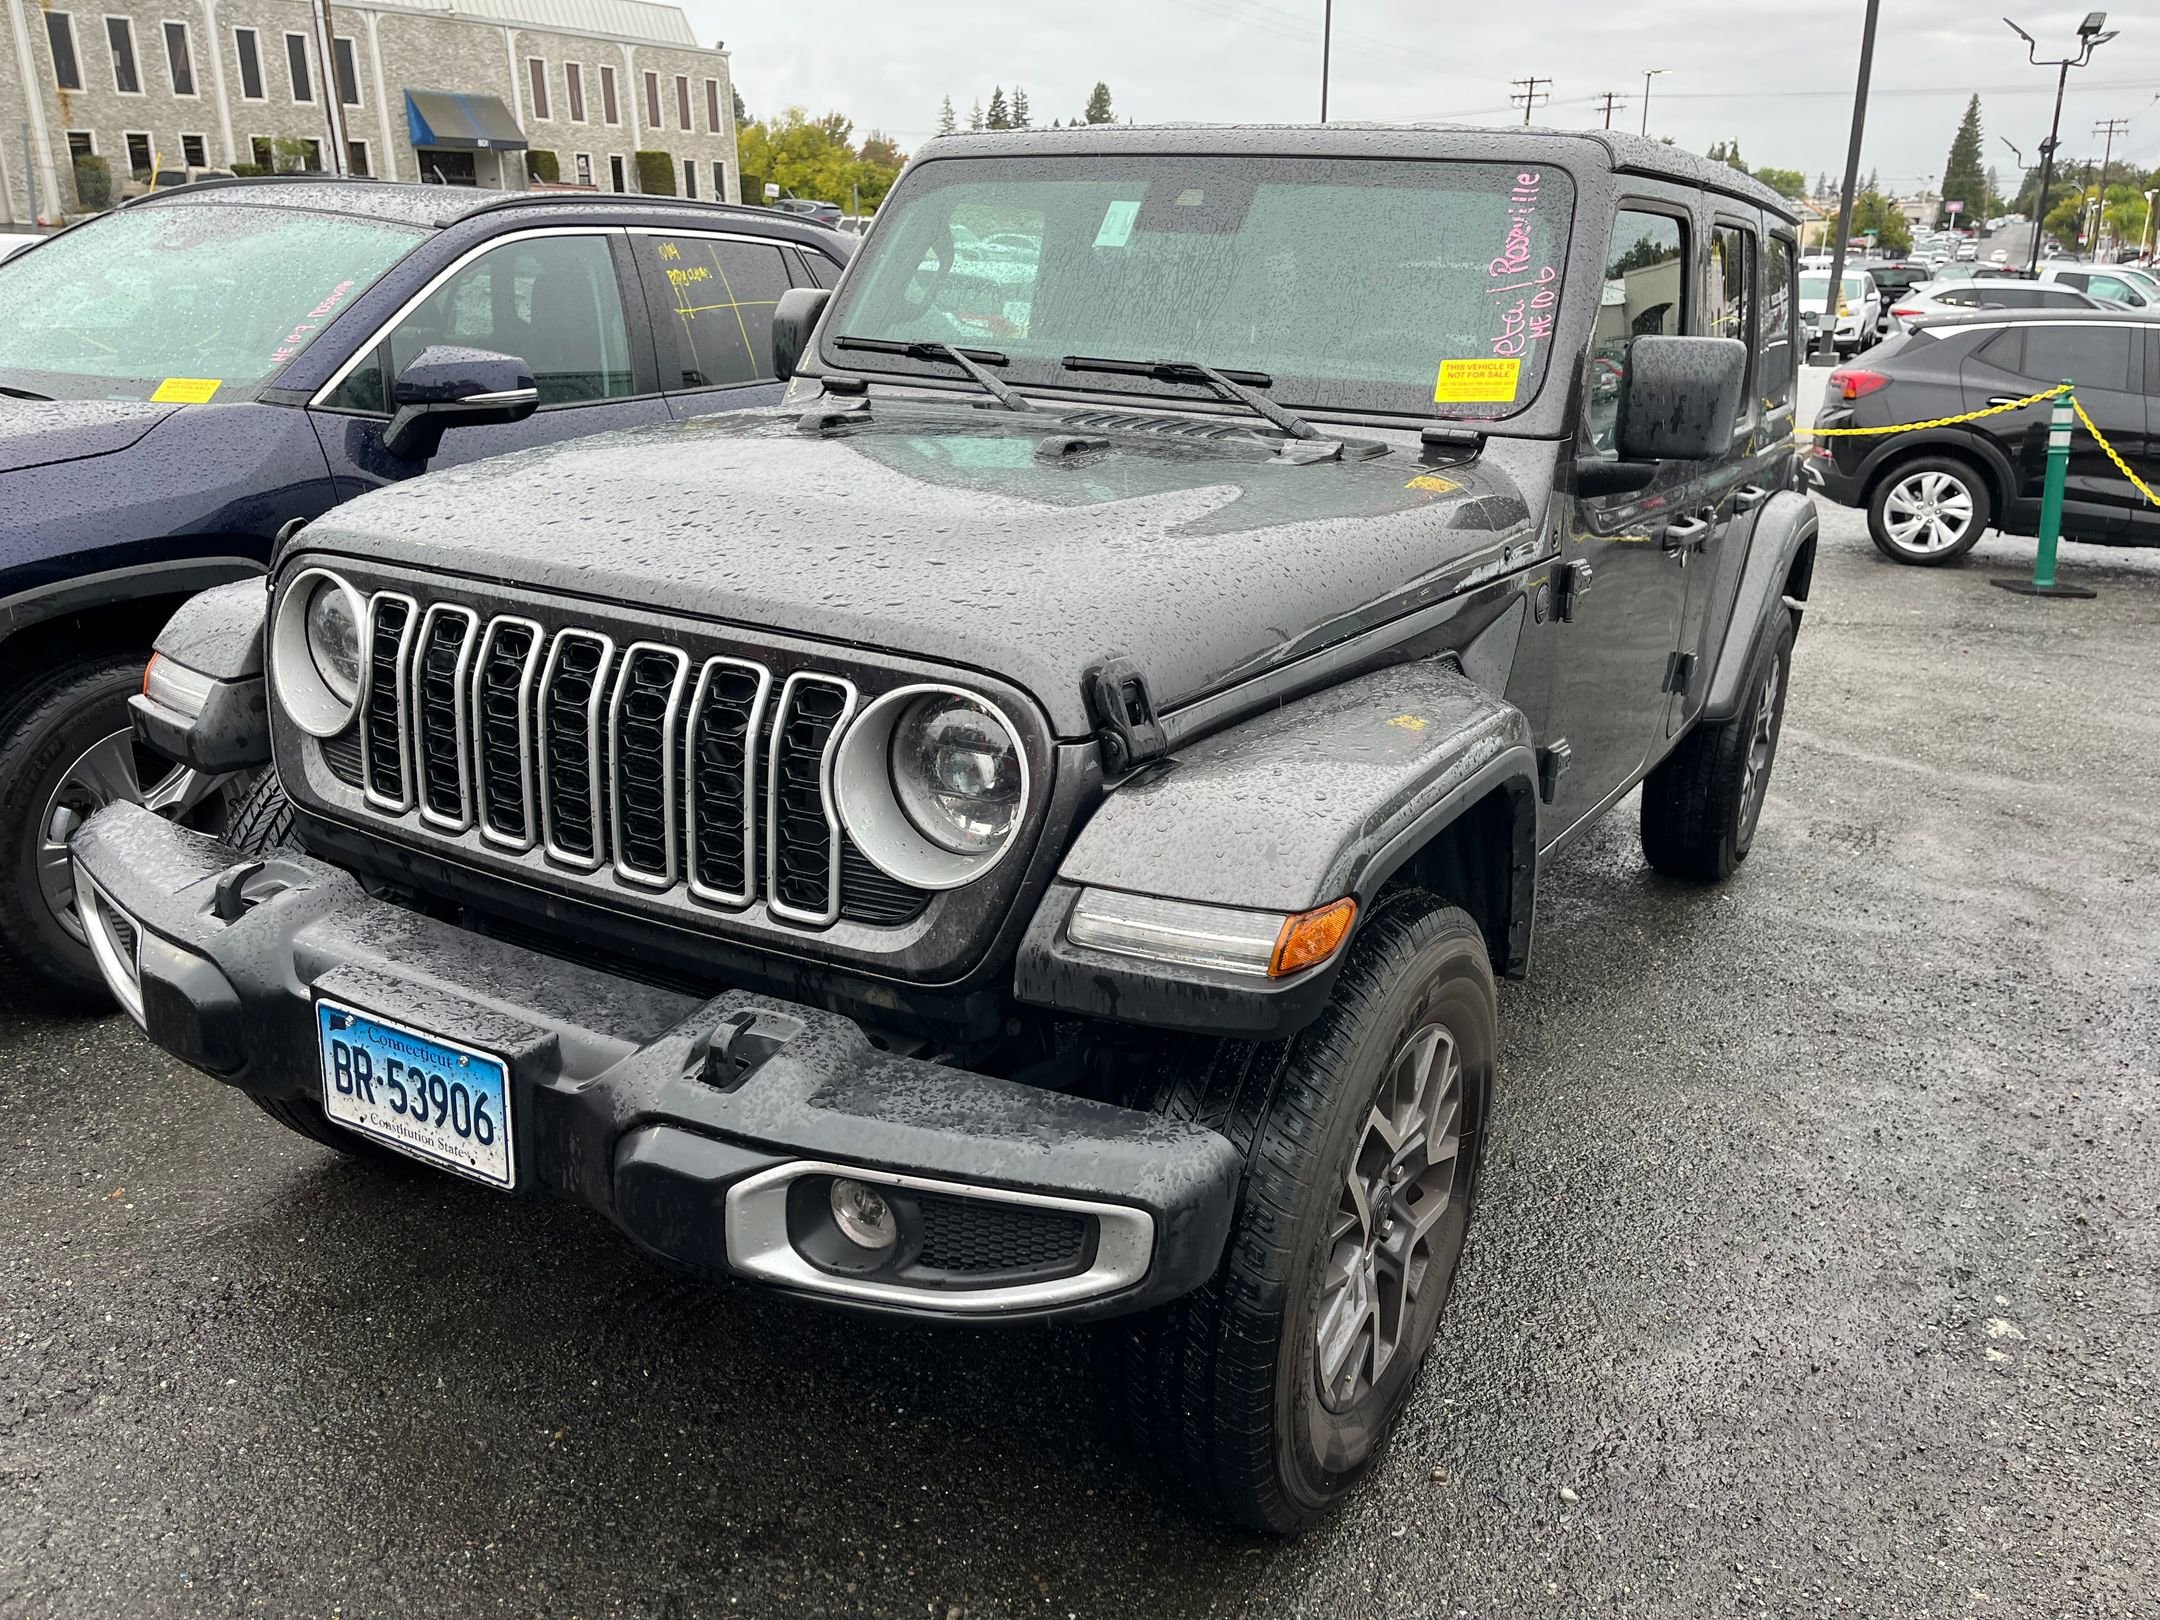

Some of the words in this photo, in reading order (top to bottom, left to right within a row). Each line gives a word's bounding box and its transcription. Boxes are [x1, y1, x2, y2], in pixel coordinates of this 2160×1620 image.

[1446, 363, 1465, 371] THIS
[1467, 362, 1505, 371] VEHICLE
[1506, 362, 1516, 370] IS
[1447, 371, 1467, 379] NOT
[1467, 371, 1486, 379] FOR
[1487, 371, 1511, 379] SALE
[367, 1026, 452, 1069] Connecticut
[370, 1111, 435, 1147] Constitution
[437, 1137, 465, 1159] State
